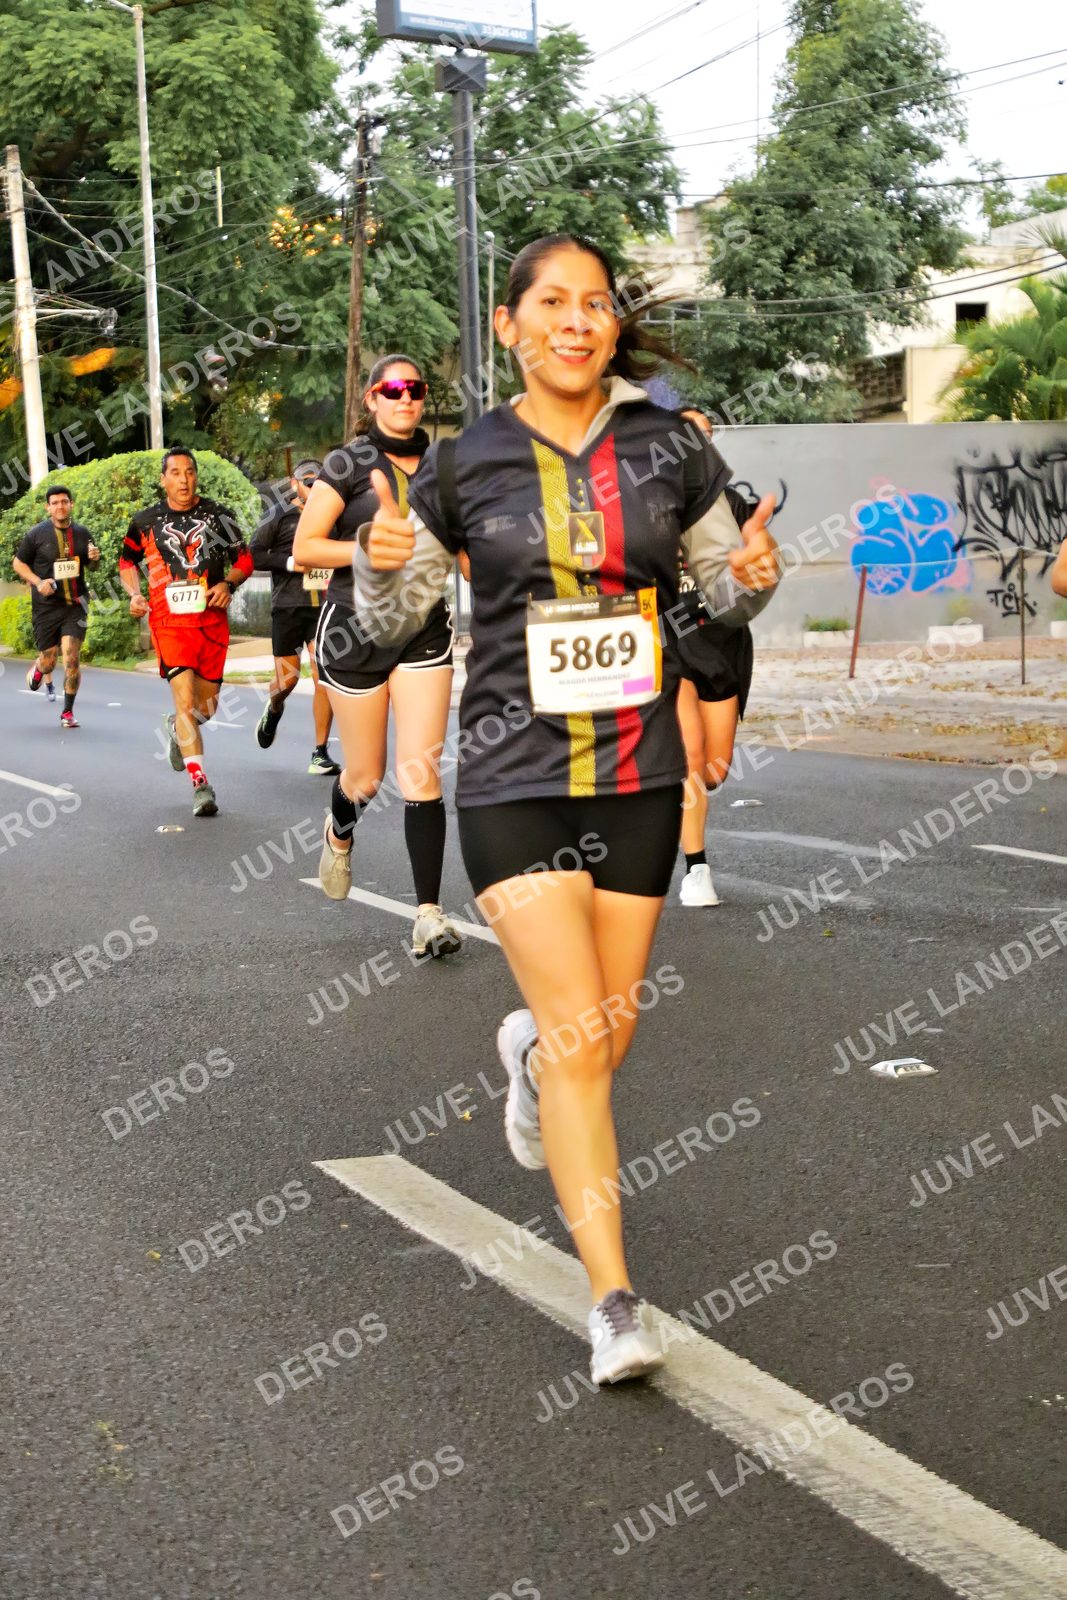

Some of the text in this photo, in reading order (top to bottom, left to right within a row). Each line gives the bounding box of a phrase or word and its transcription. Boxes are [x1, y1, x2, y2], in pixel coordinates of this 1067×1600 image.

[308, 570, 329, 580] 6445
[172, 590, 199, 602] 6777
[549, 630, 638, 674] 5869
